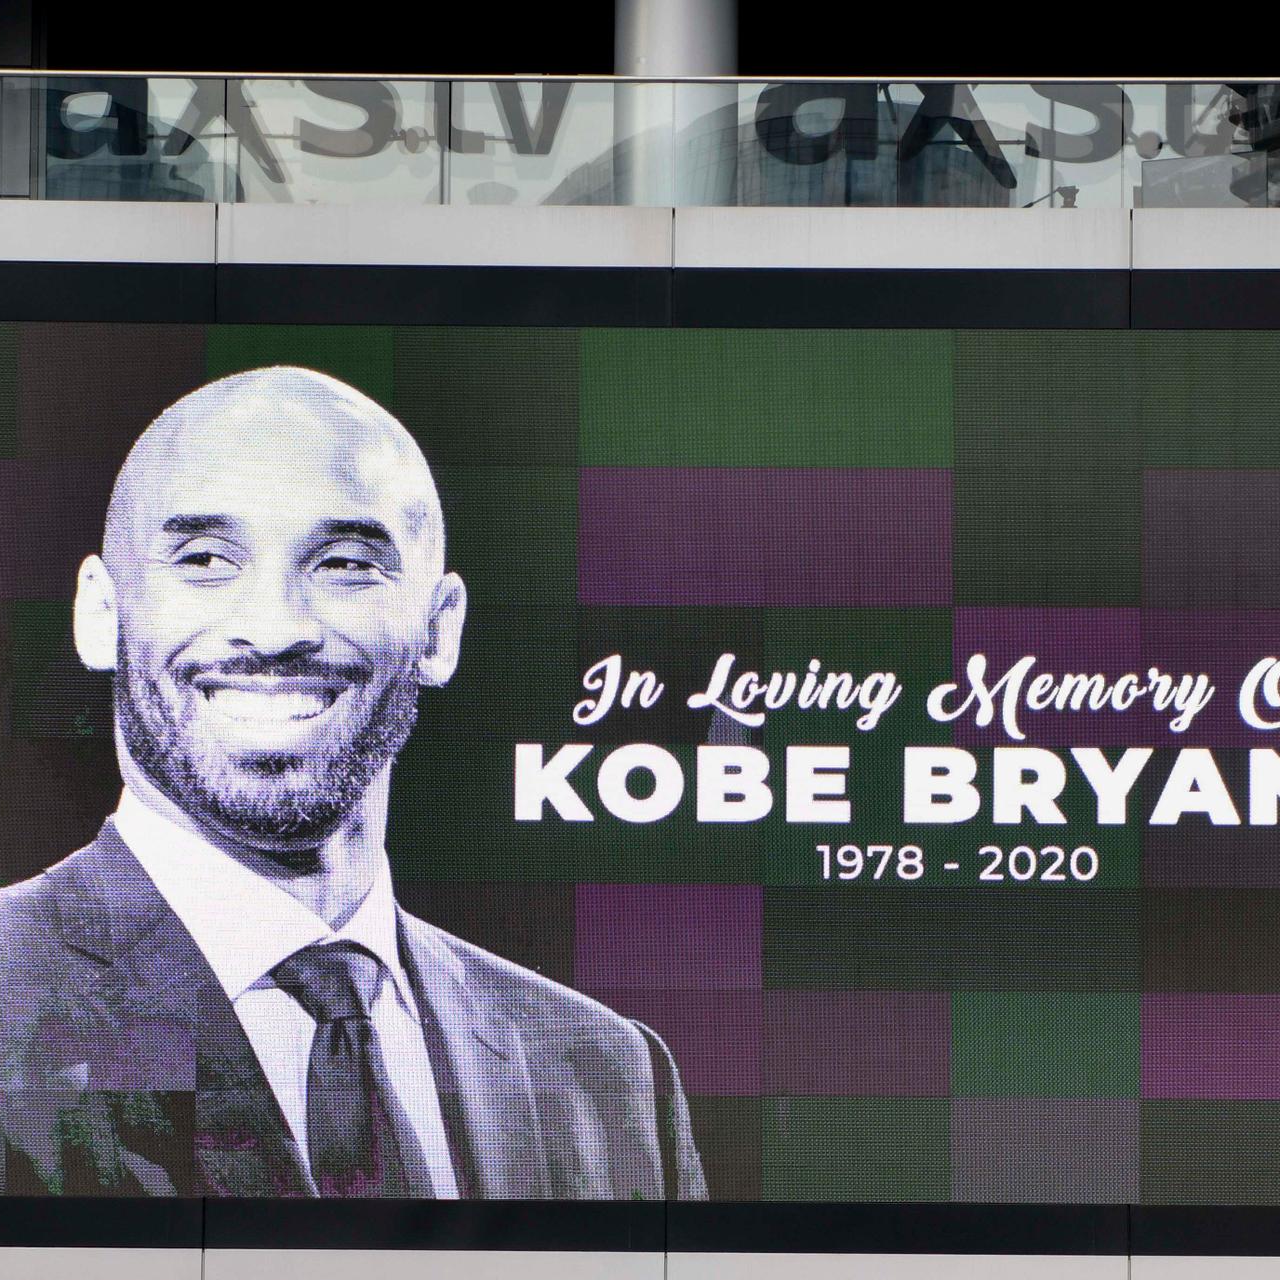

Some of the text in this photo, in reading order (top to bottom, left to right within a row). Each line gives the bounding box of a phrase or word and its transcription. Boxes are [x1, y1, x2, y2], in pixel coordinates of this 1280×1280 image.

[573, 653, 664, 726] In
[686, 652, 903, 731] Loving
[926, 653, 1215, 741] Memory
[514, 743, 852, 823] KOBE
[816, 844, 924, 880] 1978
[977, 845, 1099, 881] 2020
